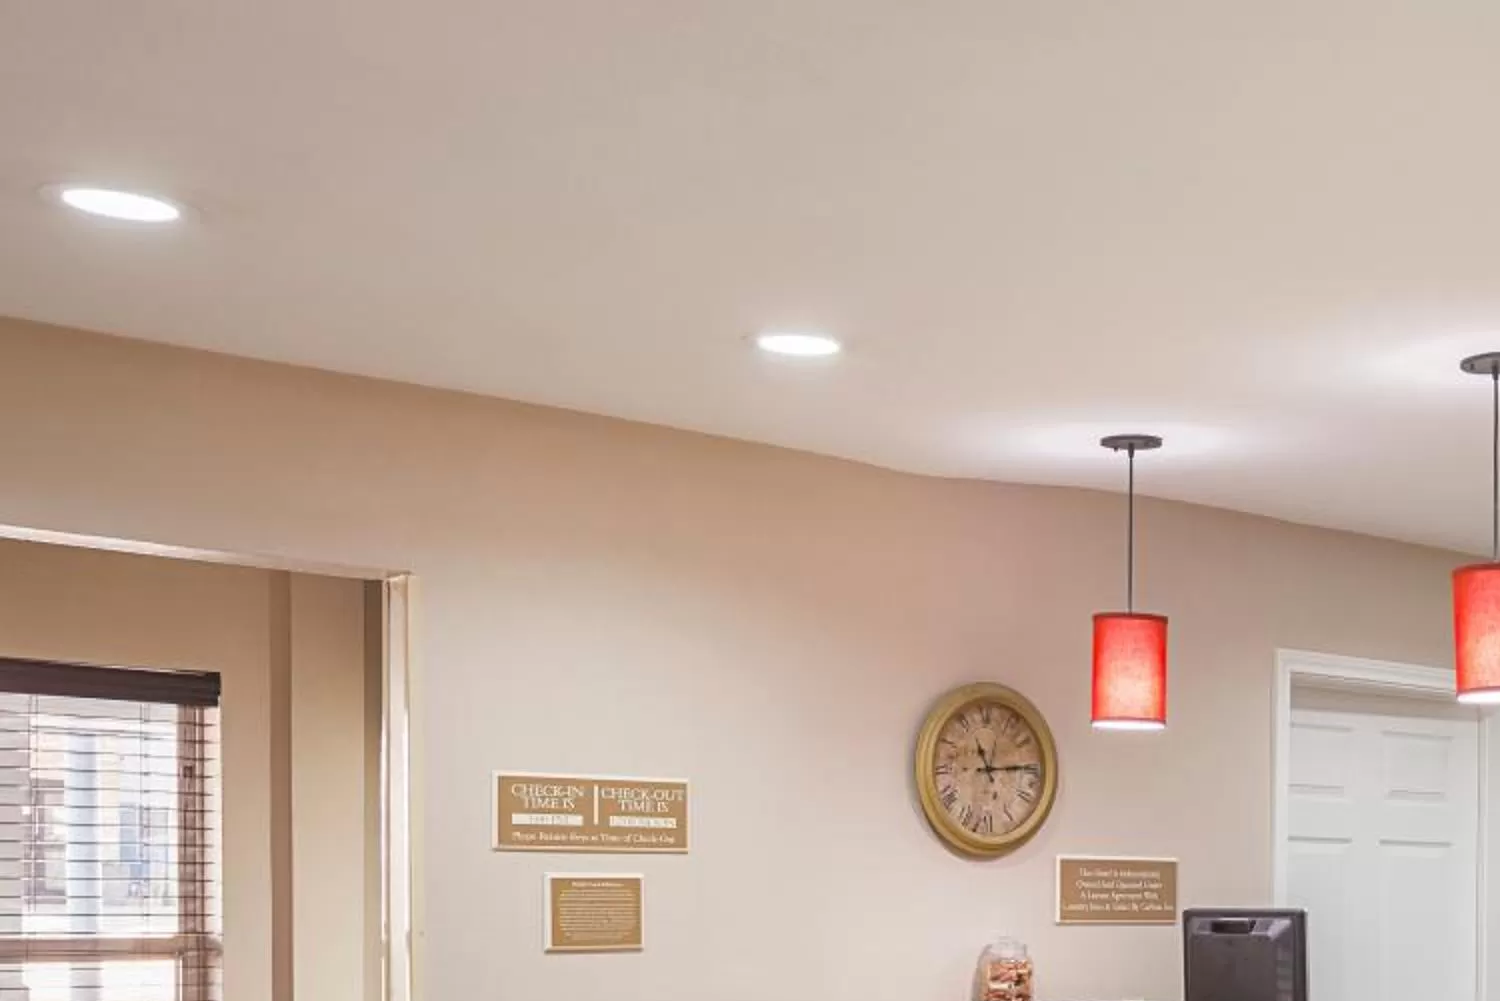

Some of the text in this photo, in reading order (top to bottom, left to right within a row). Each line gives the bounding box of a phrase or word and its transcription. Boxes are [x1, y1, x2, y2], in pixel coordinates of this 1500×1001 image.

[511, 783, 584, 797] CHECK-IN
[601, 787, 685, 801] CHECK-OUT
[521, 797, 576, 809] TIME IS
[618, 799, 669, 812] TIME IS
